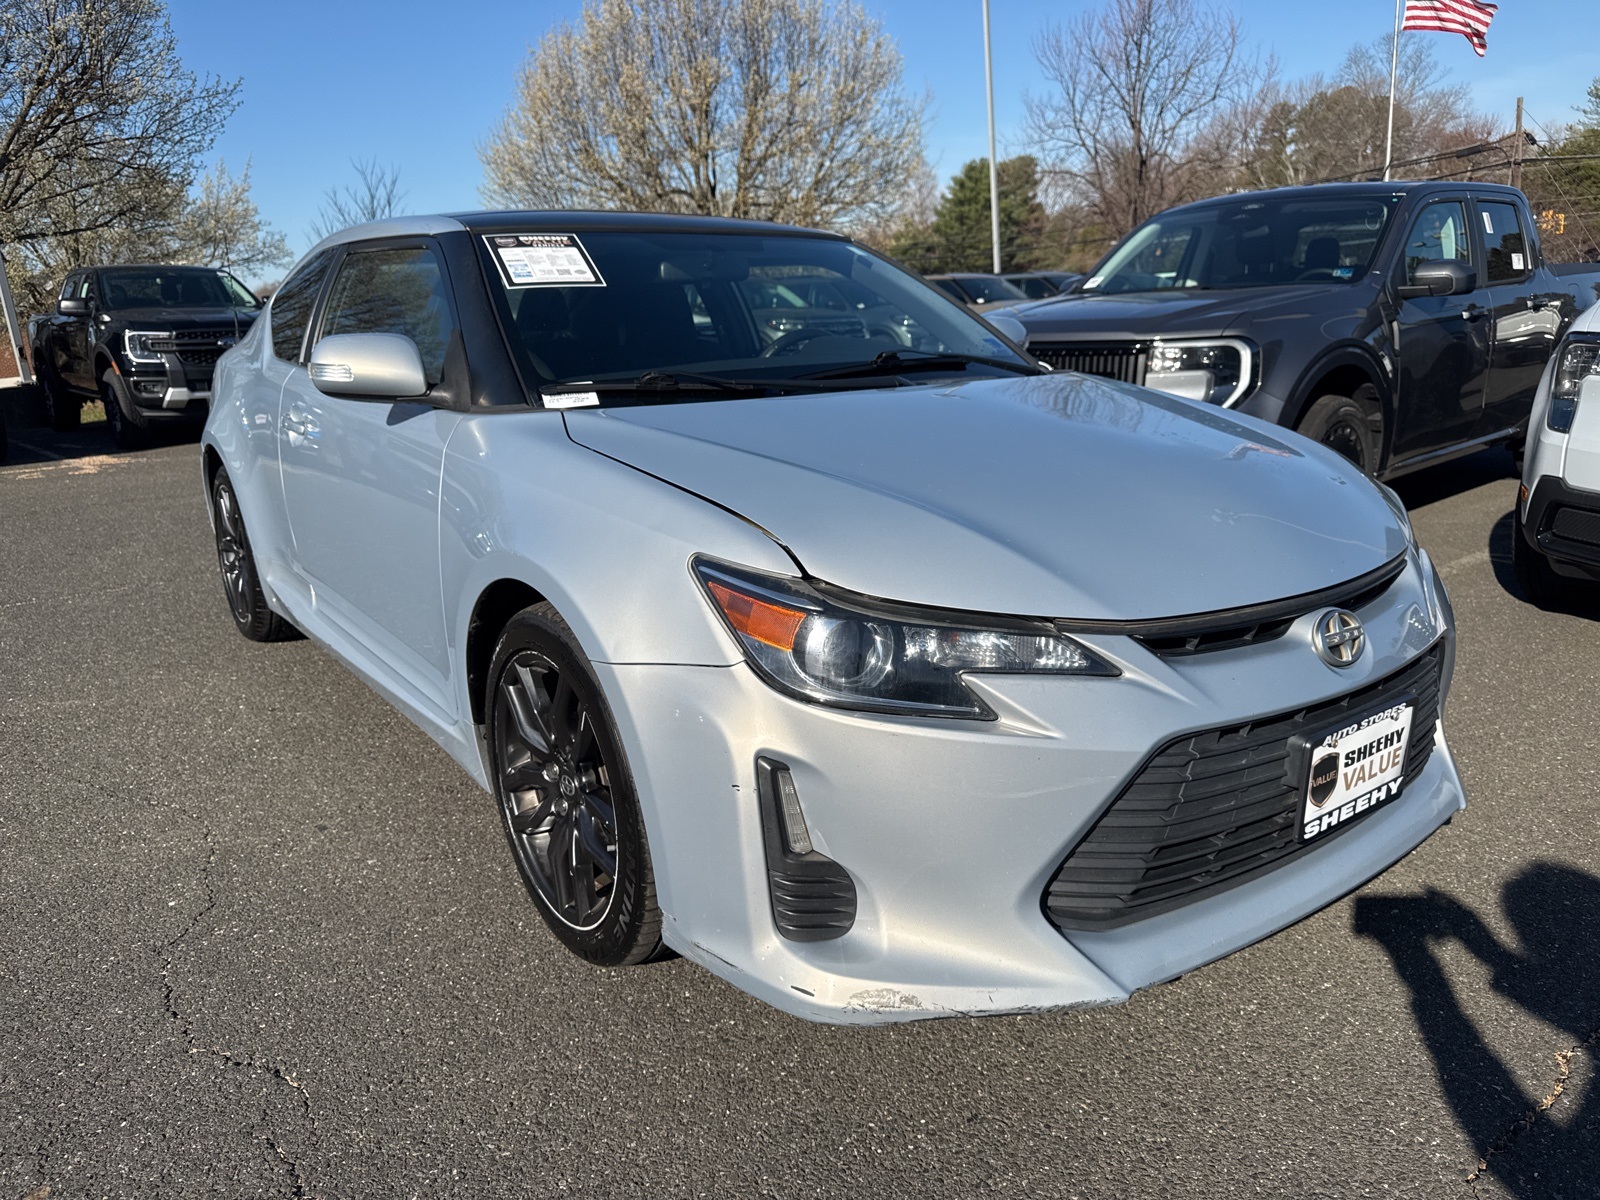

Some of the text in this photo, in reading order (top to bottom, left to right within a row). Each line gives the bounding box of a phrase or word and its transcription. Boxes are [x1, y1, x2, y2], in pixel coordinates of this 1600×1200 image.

[1322, 702, 1407, 747] AUTO STORES
[1343, 726, 1406, 769] SHEEHY
[1343, 745, 1403, 791] VALUE
[1311, 769, 1337, 788] VALUE
[1303, 776, 1404, 840] SHEEHY
